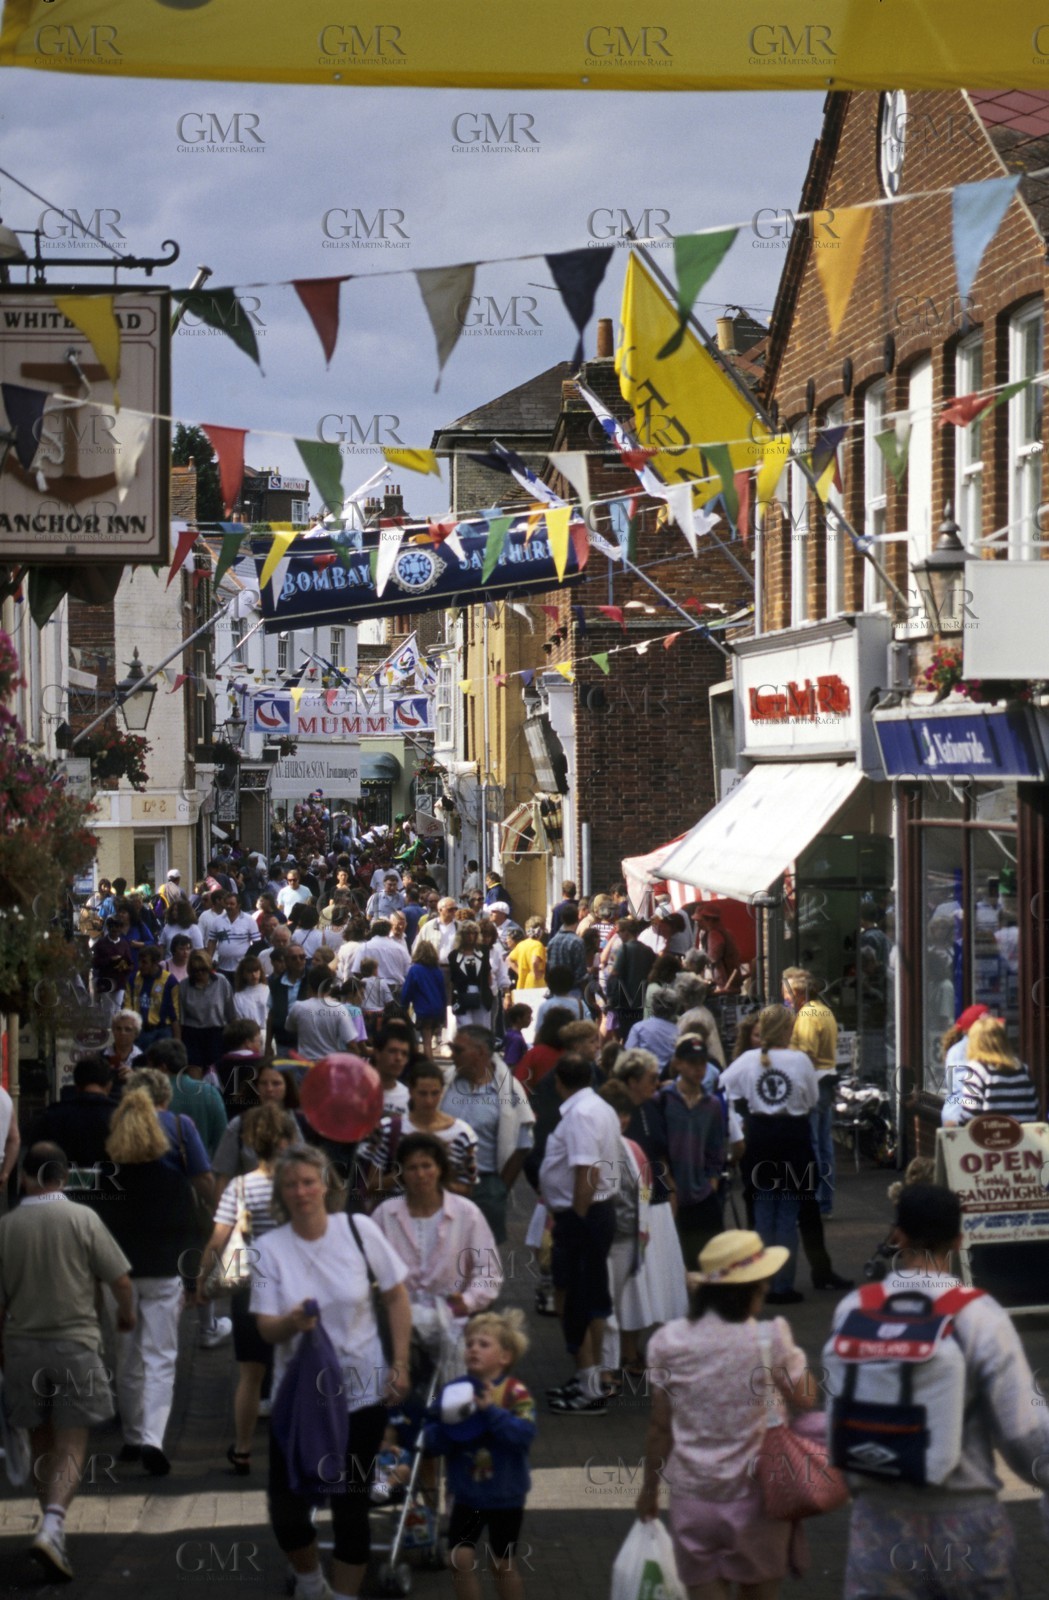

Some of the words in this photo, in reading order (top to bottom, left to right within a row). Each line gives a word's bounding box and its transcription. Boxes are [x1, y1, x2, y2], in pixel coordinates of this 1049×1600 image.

[0, 513, 101, 534] ANCHOR
[106, 515, 147, 534] INN
[279, 564, 375, 600] BOMBAY
[297, 716, 386, 734] MUMM
[284, 760, 306, 778] HURST
[311, 760, 325, 778] SON
[959, 1150, 1044, 1174] OPEN
